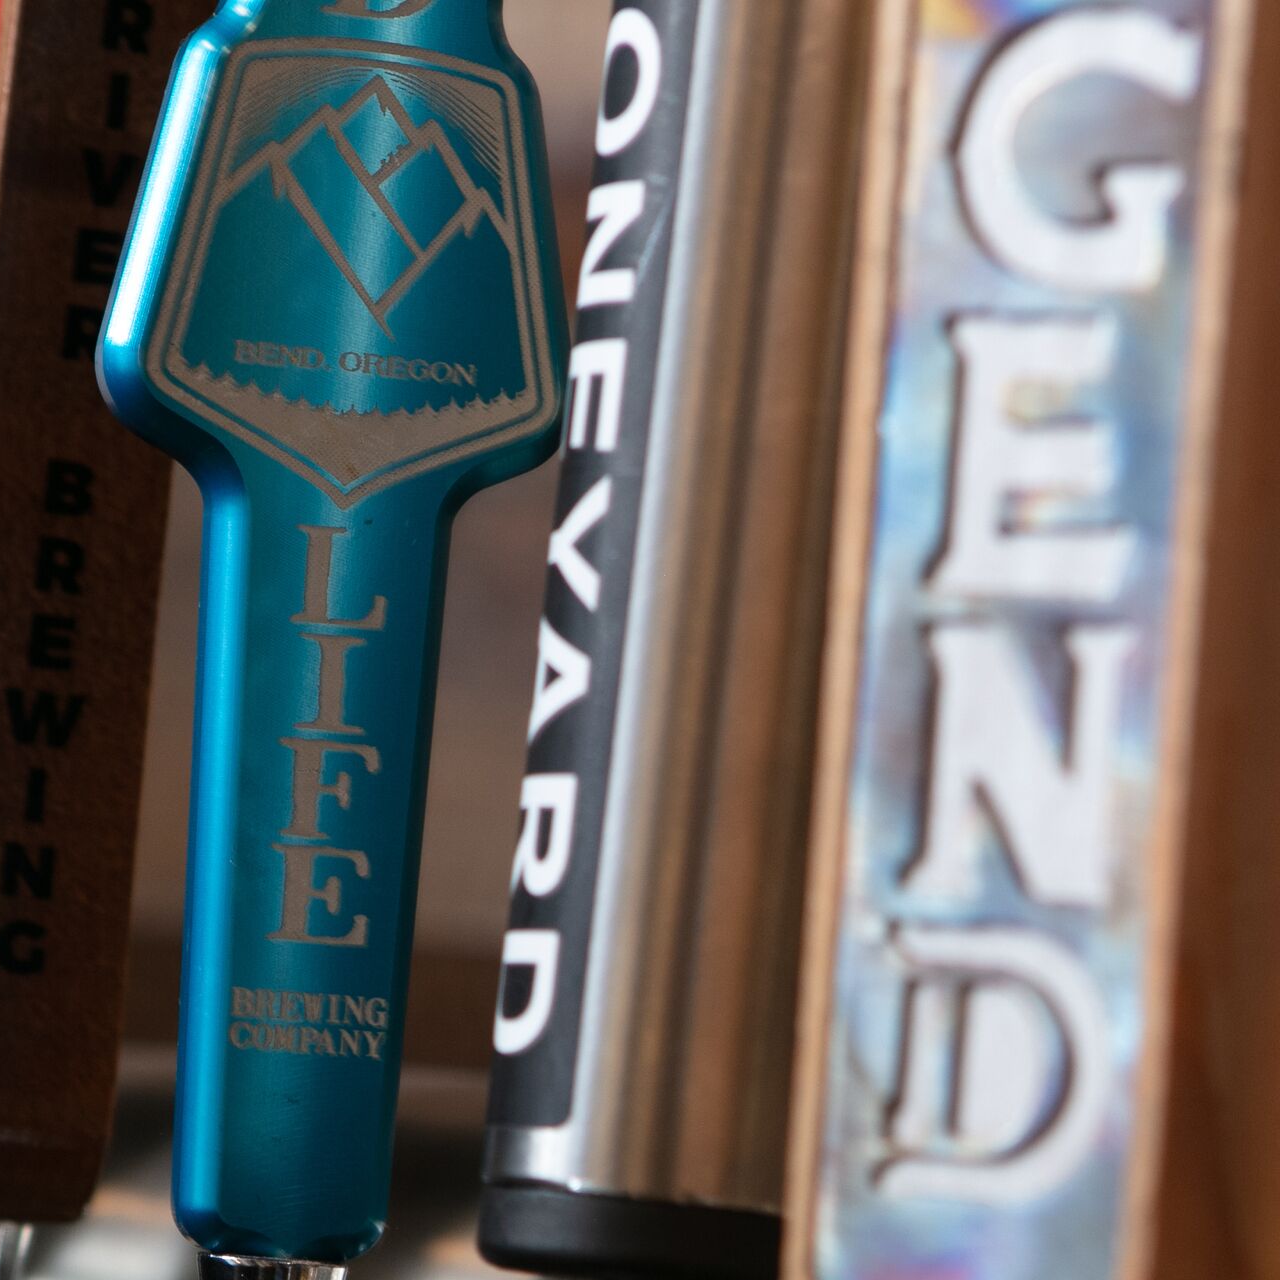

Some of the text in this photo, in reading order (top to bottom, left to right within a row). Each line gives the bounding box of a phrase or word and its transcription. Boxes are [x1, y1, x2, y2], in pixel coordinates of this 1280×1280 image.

[338, 351, 478, 387] OREGON
[492, 7, 662, 1056] ONEYARD
[870, 3, 1204, 1204] GEND
[265, 525, 388, 947] LIFE
[229, 1021, 385, 1060] COMPANY
[231, 986, 389, 1028] BREWING
